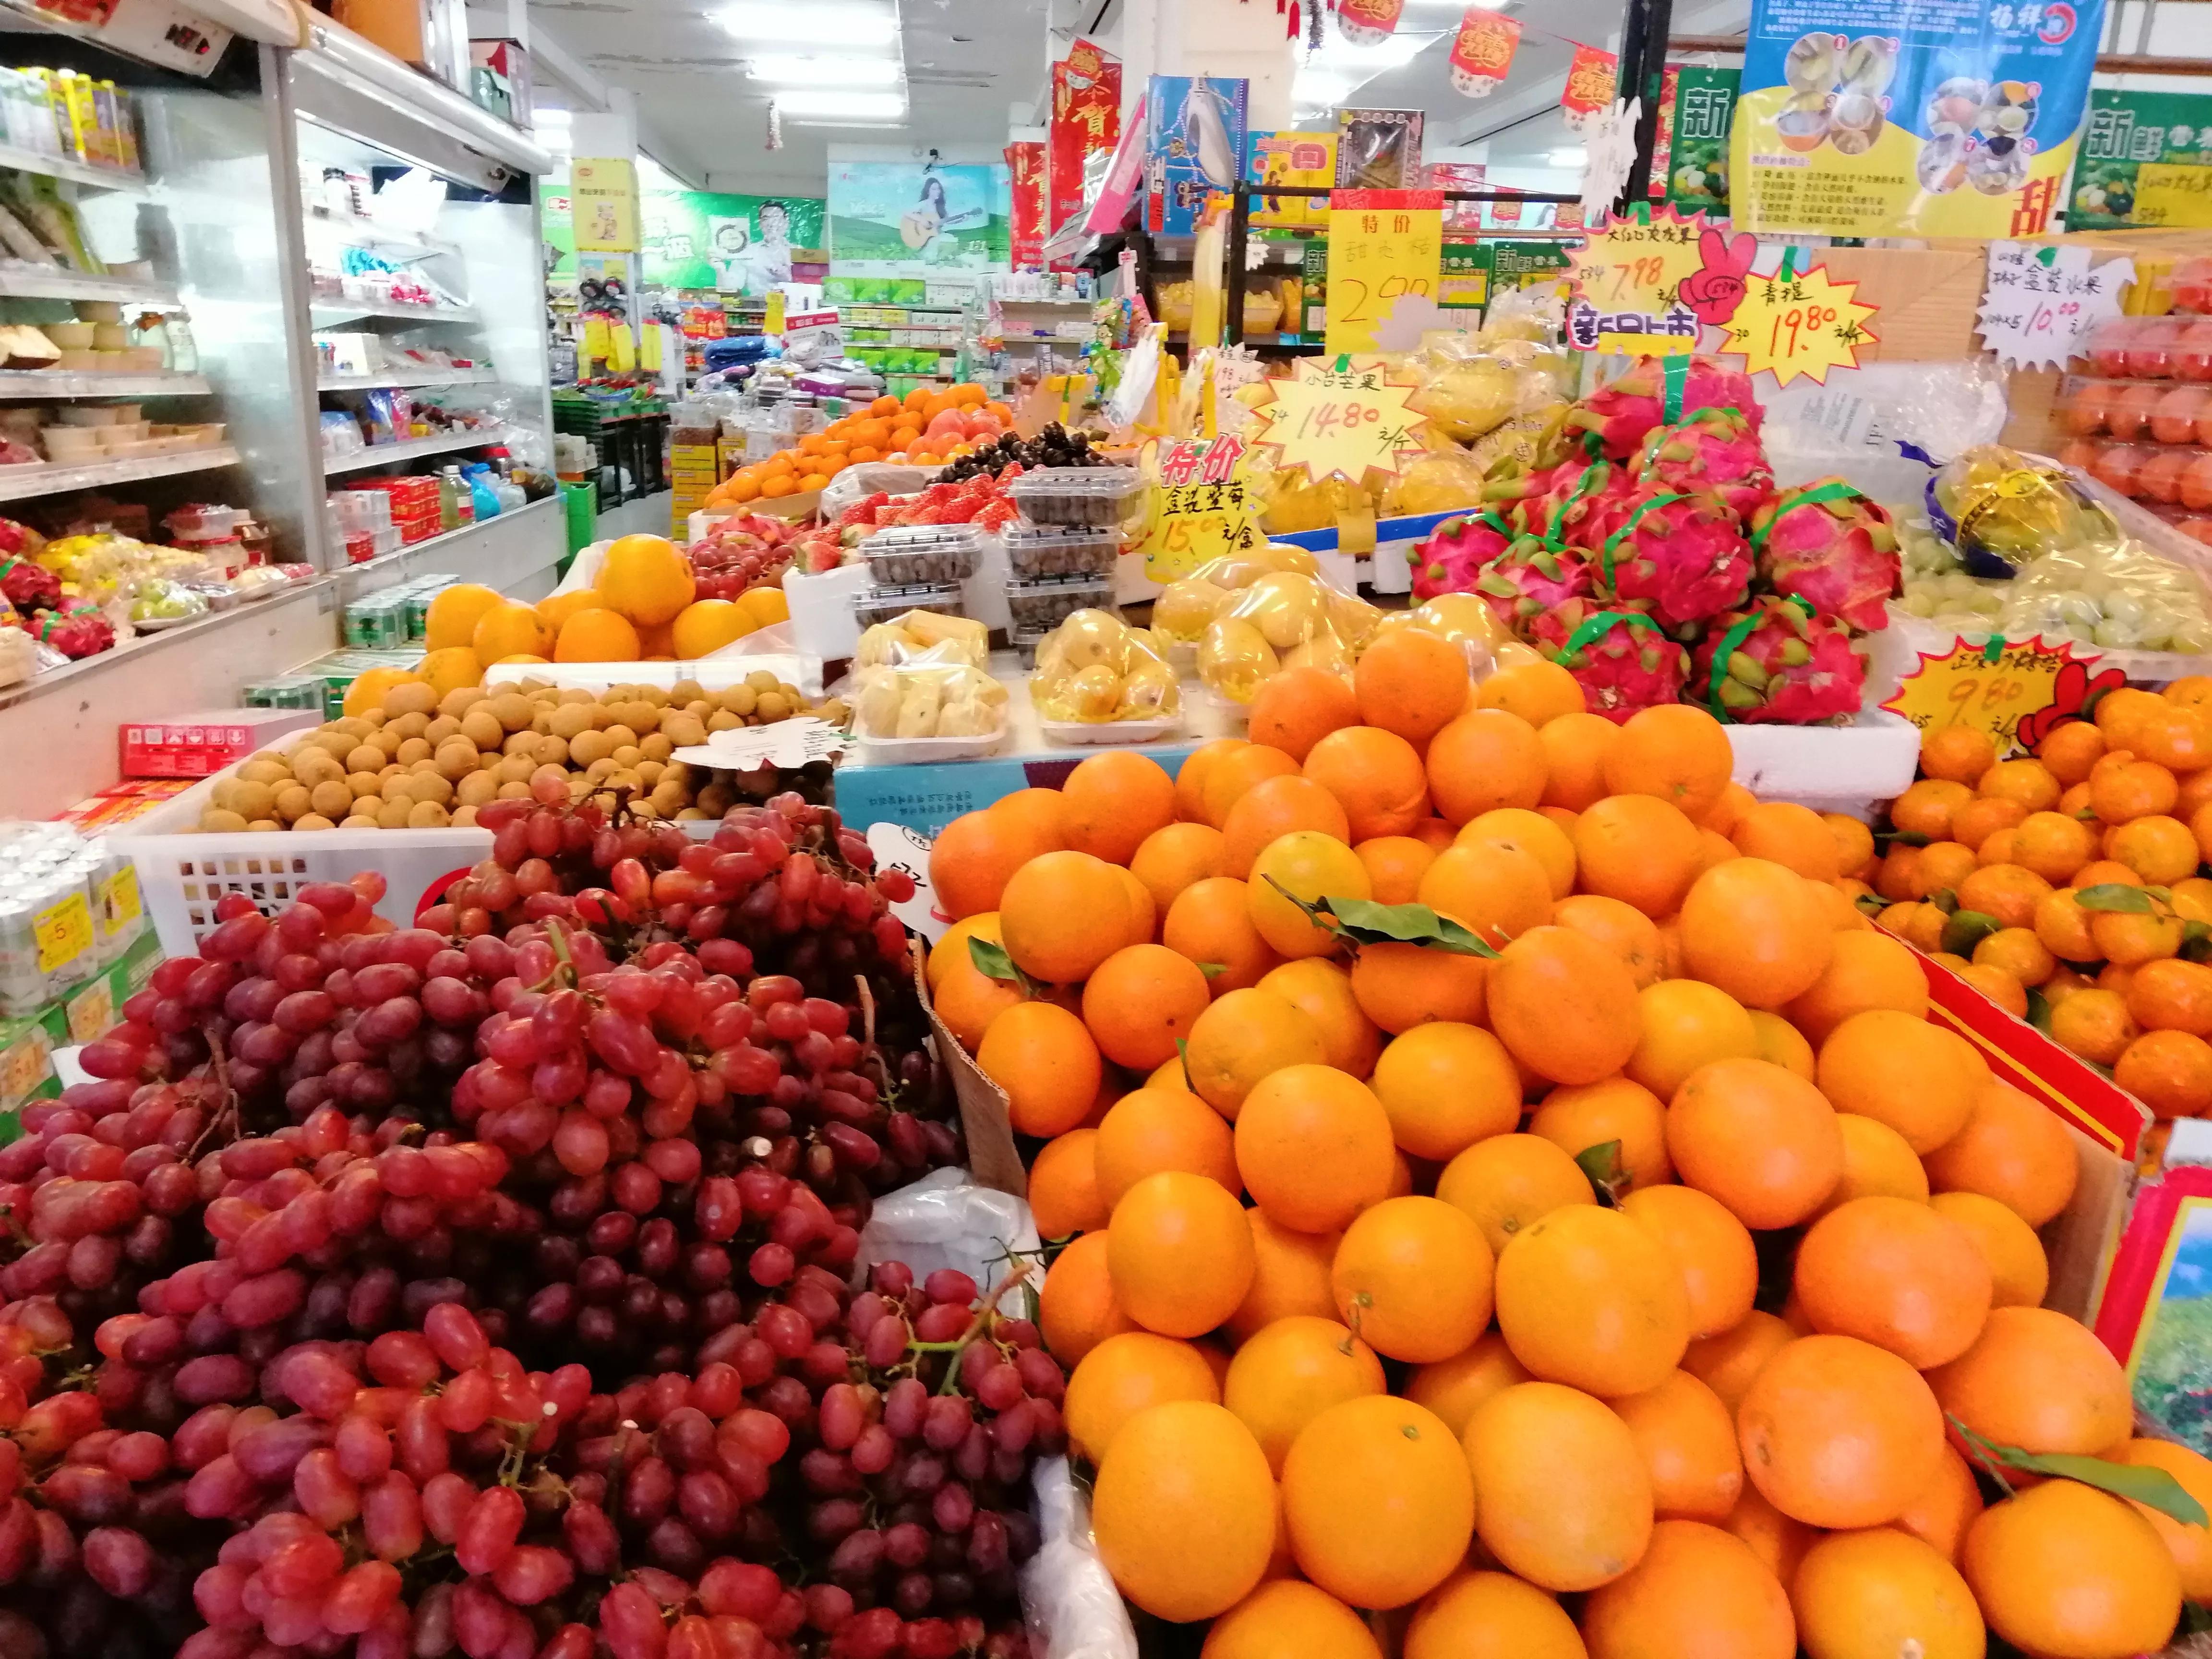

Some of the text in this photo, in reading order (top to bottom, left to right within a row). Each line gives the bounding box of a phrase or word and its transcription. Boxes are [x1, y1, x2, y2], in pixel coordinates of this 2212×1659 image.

[1682, 87, 1731, 138] 新
[1362, 215, 1410, 233] 特价
[1609, 256, 1665, 301] 7.98
[1769, 305, 1837, 358] 19.80
[1296, 402, 1381, 440] 14.80
[1162, 433, 1247, 488] 特价
